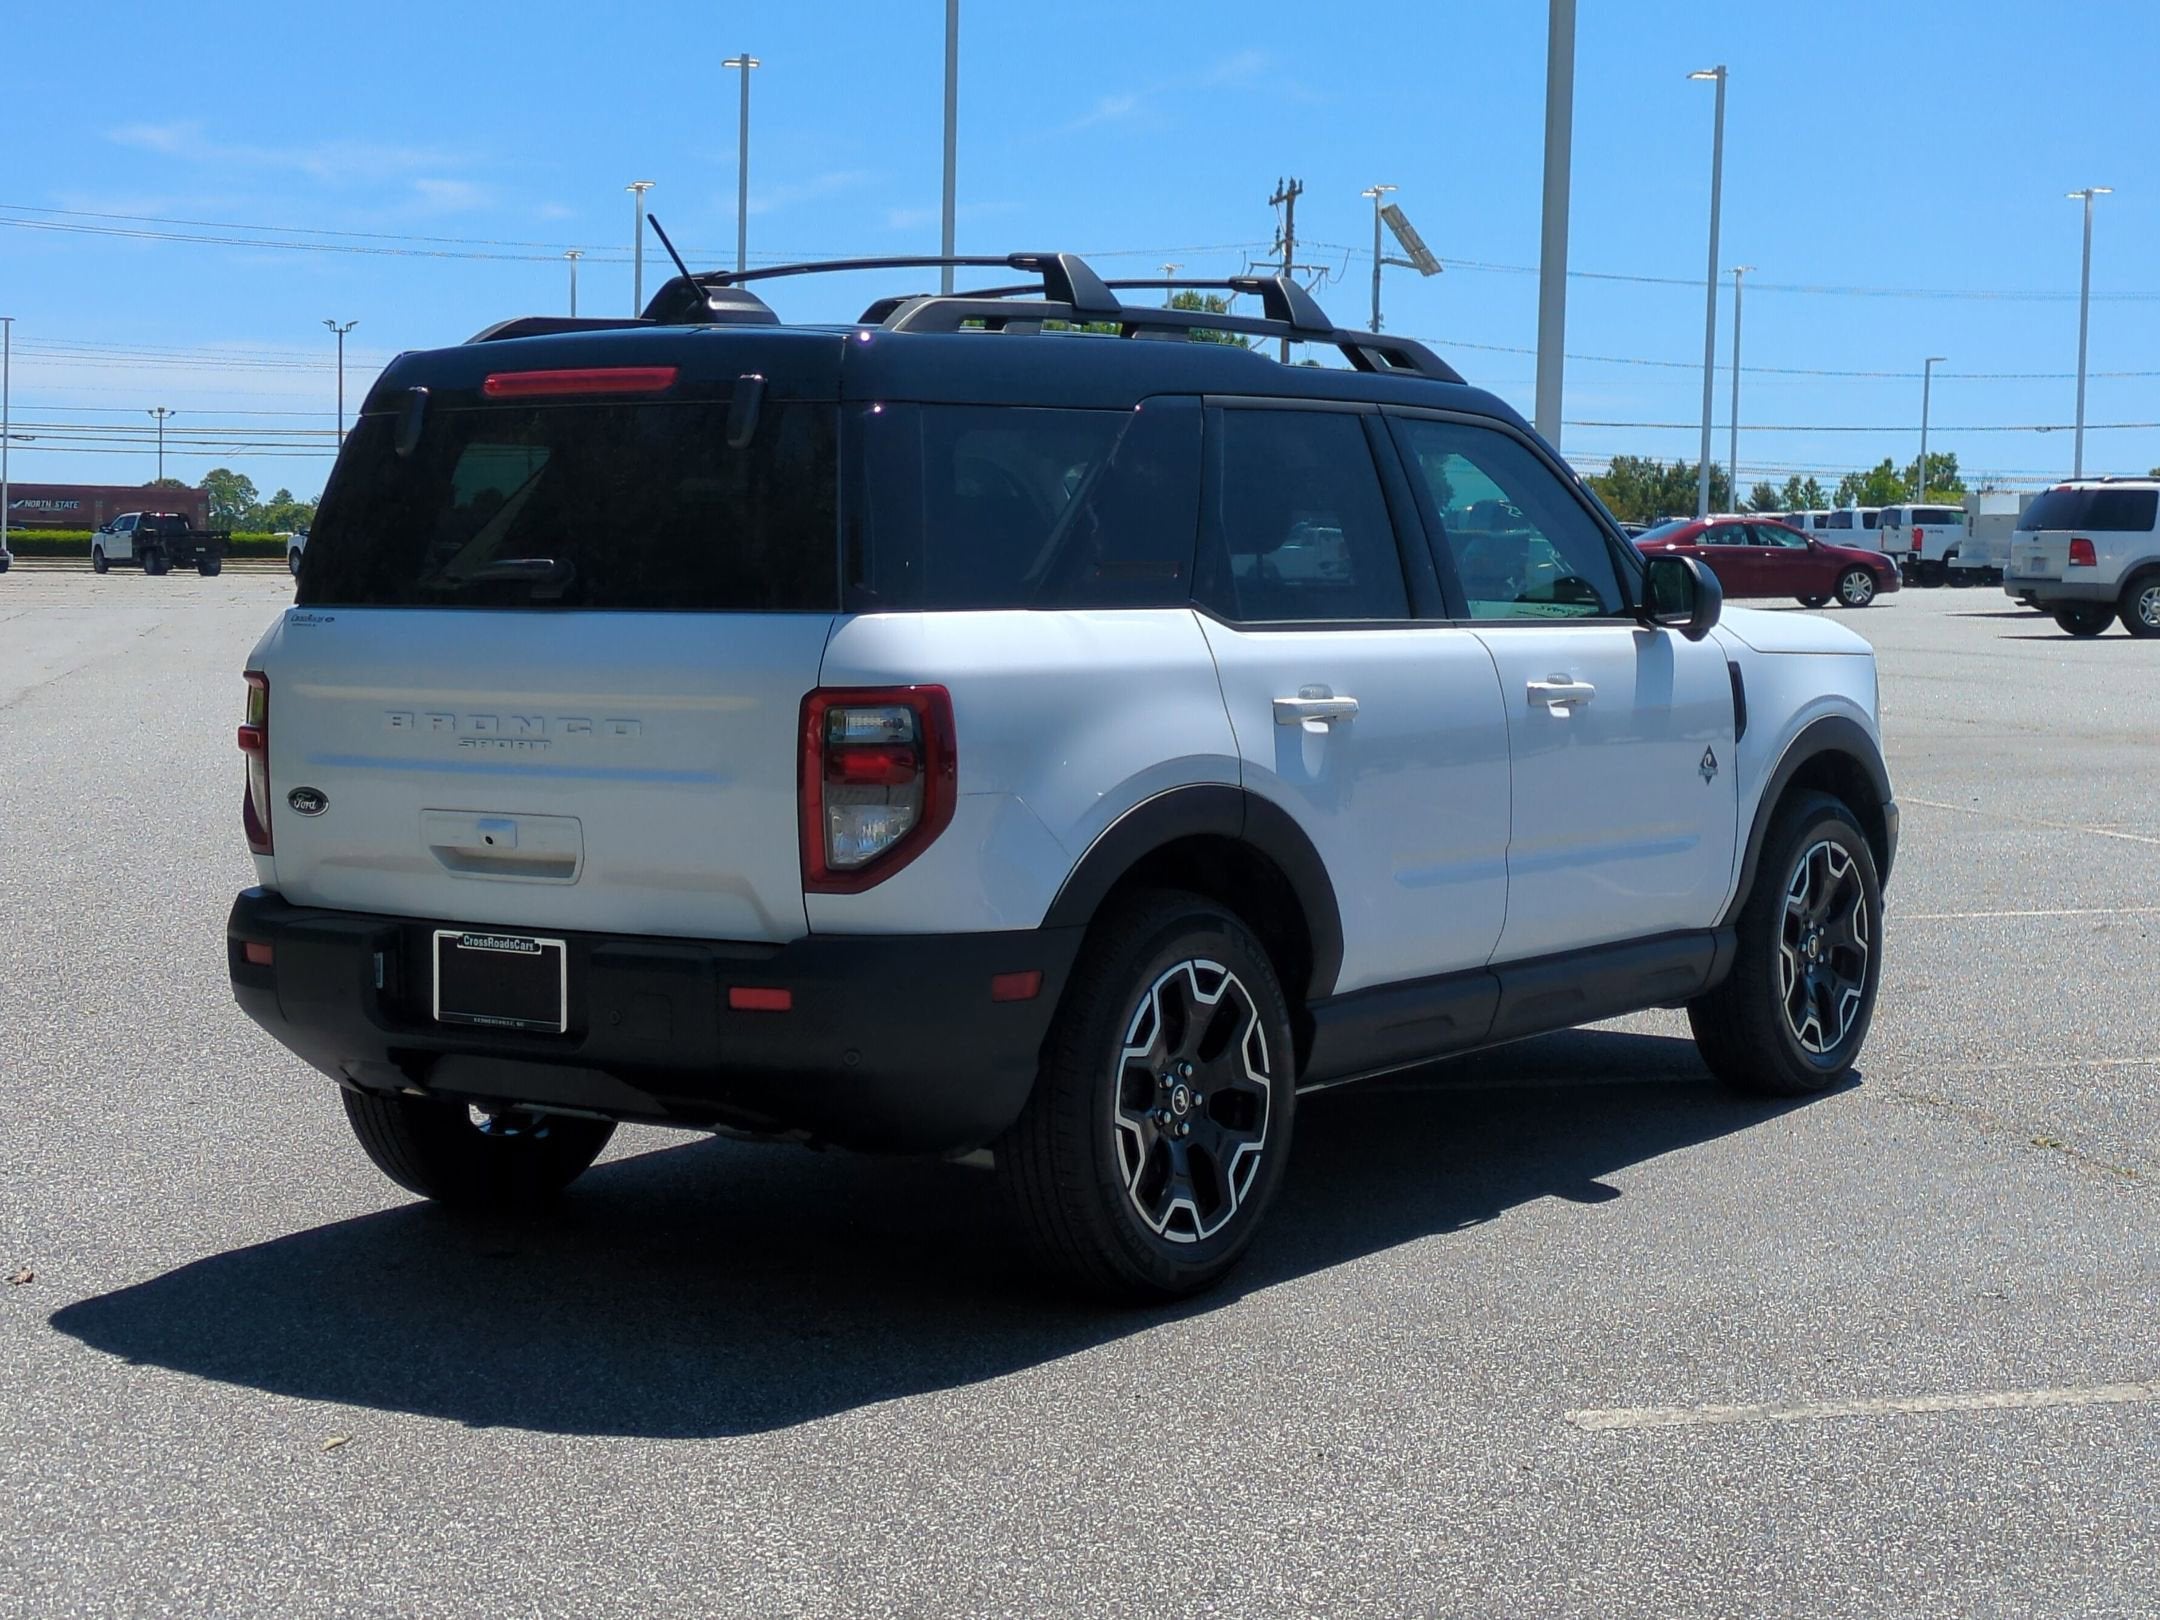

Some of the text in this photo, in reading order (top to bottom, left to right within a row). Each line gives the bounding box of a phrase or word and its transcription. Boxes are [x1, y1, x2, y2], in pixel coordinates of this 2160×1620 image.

[24, 500, 80, 509] NORTH STATE
[384, 711, 642, 738] BRONCO
[458, 737, 552, 750] SPORT
[293, 793, 318, 810] Ford
[463, 935, 534, 951] CrossRoadsCars
